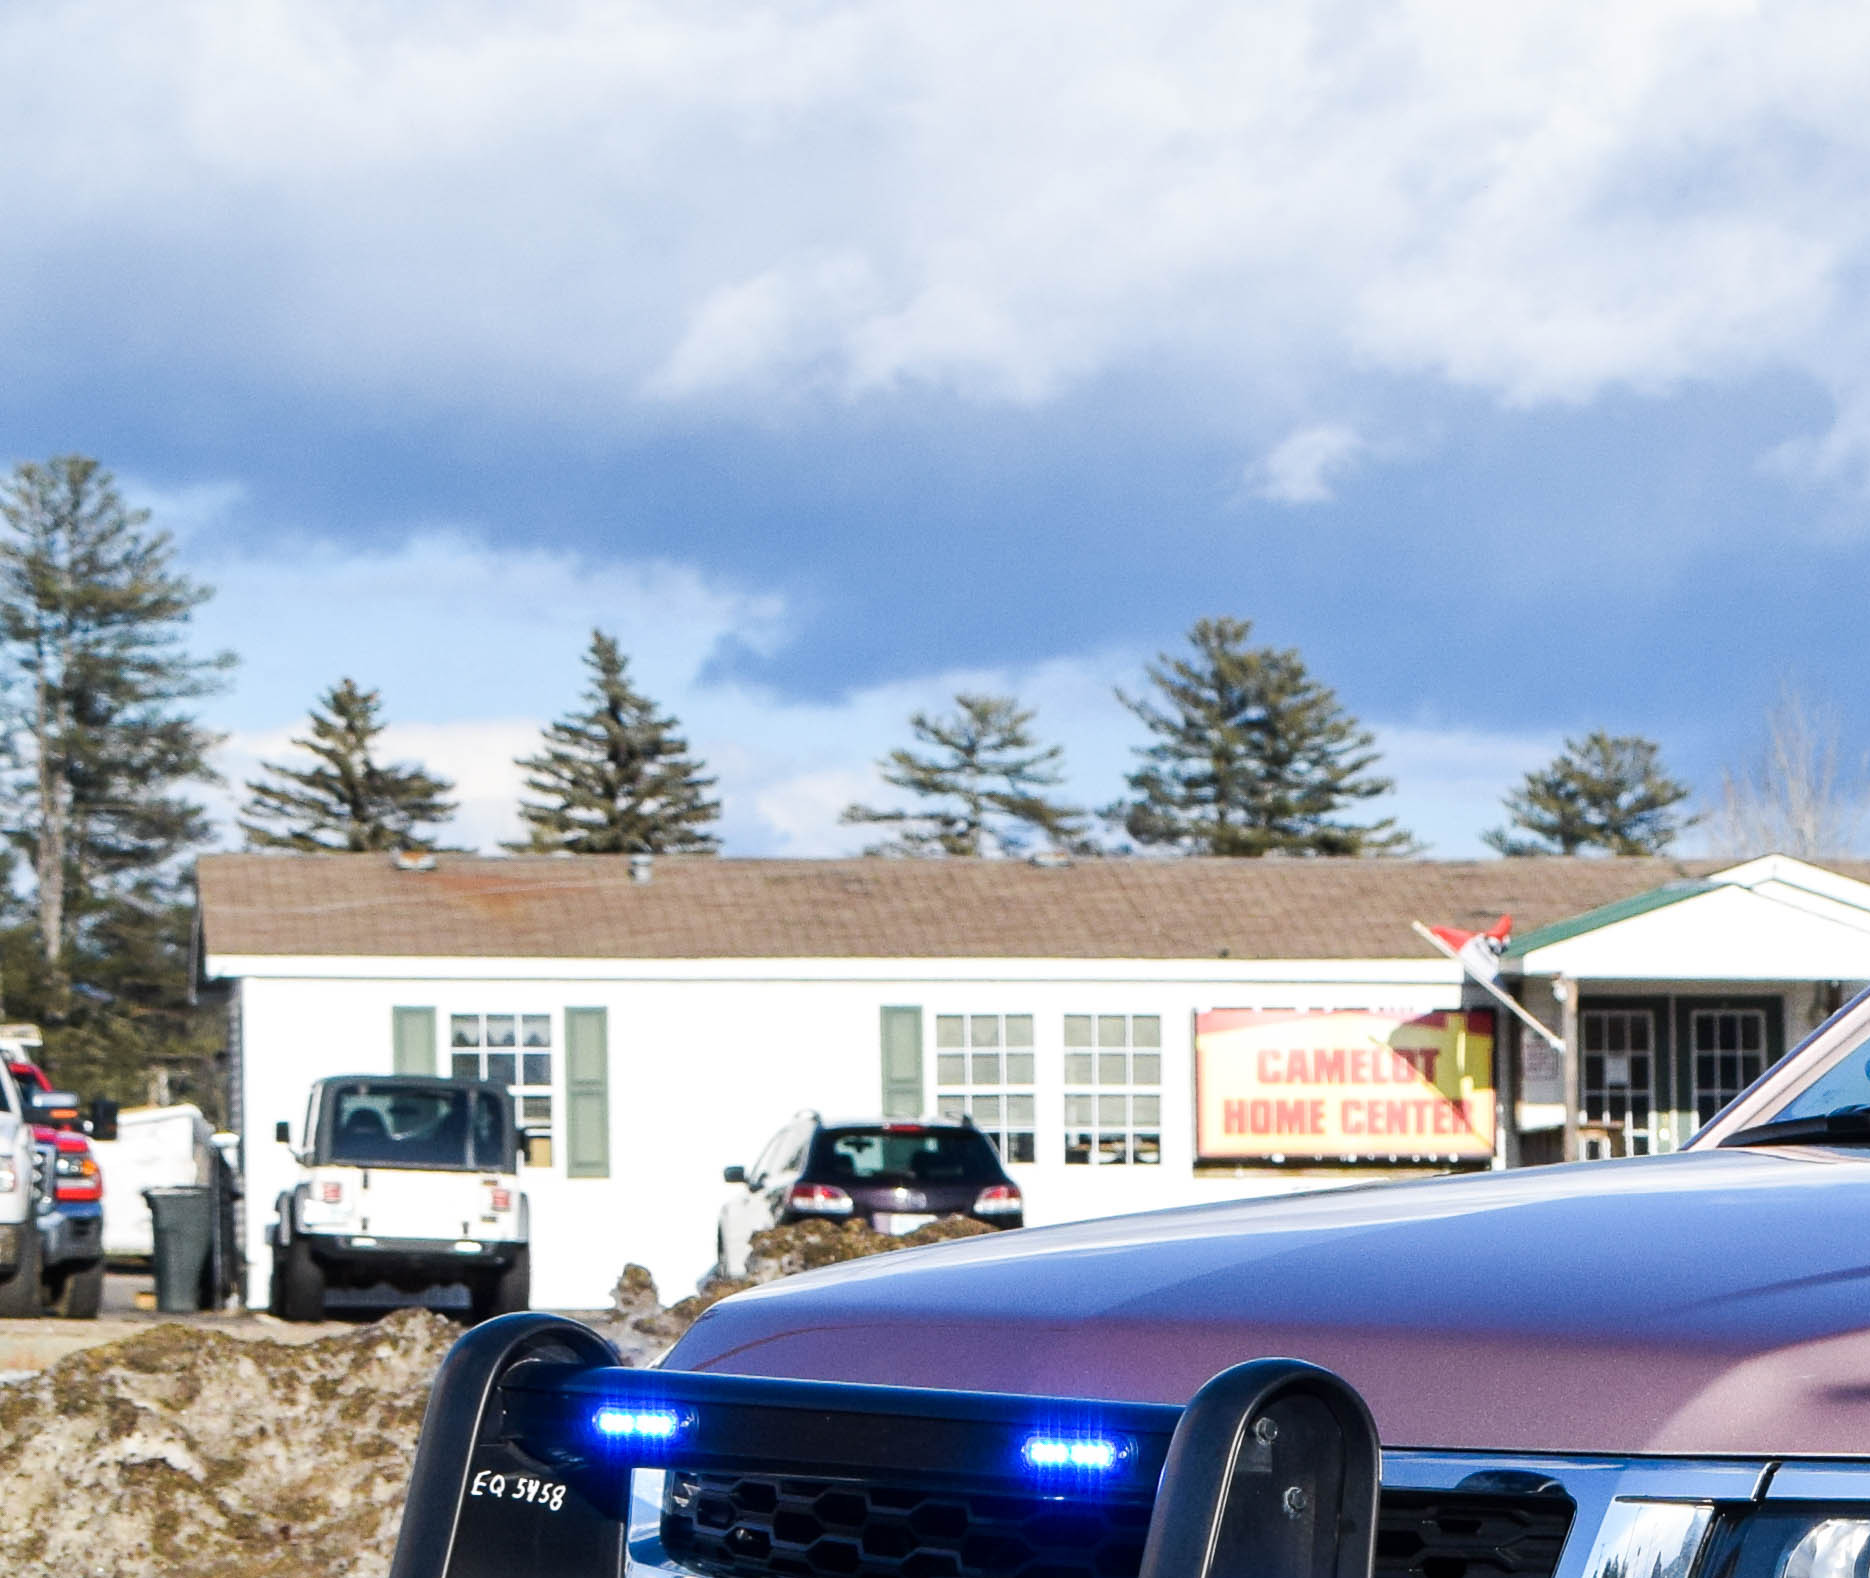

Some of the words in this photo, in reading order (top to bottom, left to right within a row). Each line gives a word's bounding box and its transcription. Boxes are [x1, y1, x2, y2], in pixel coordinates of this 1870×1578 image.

[1257, 1048, 1440, 1086] CAMELOT
[1223, 1099, 1326, 1137] HOME
[1340, 1099, 1474, 1137] CENTER
[470, 1470, 506, 1498] EQ
[511, 1478, 567, 1511] 5458
